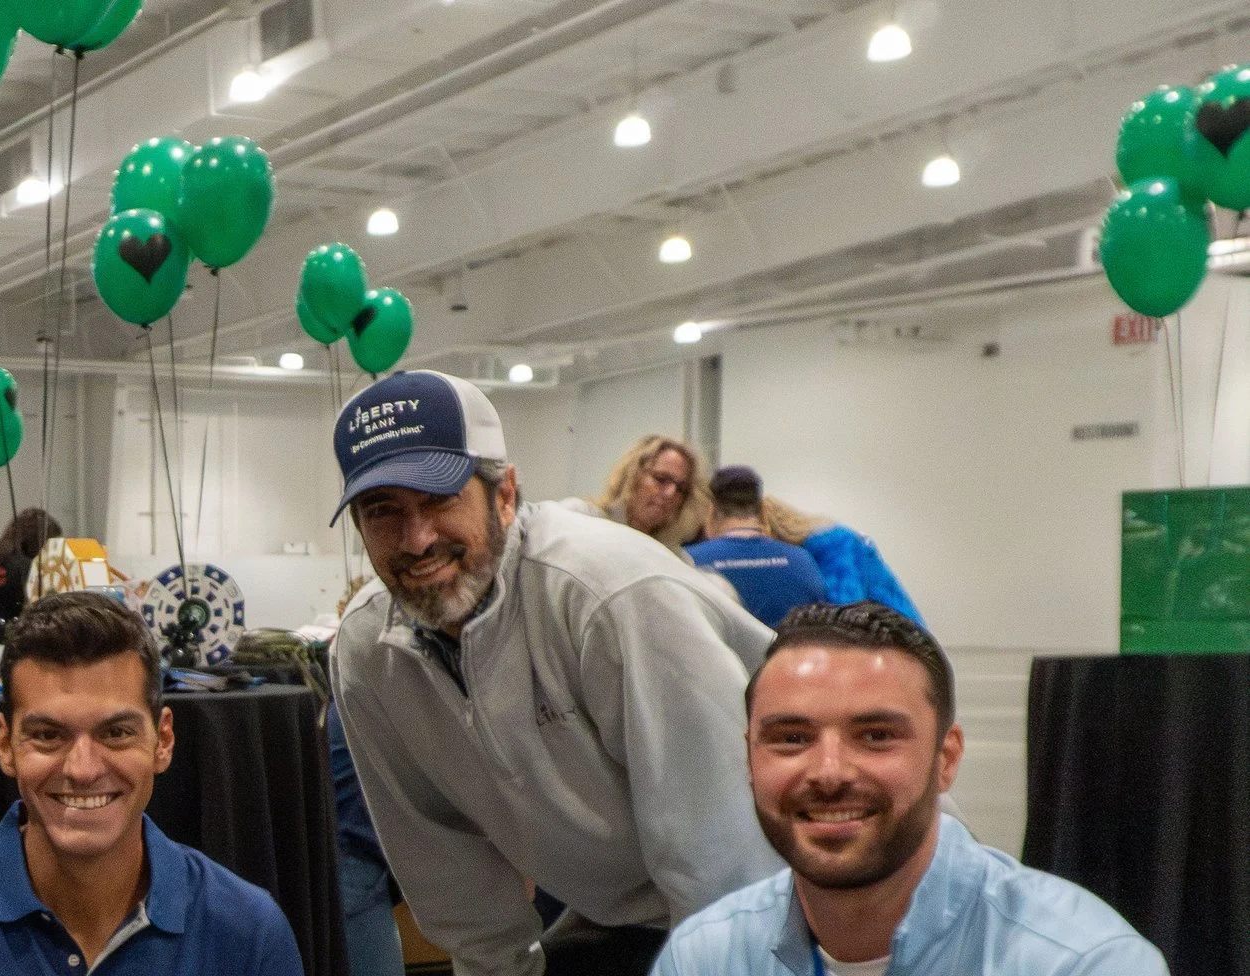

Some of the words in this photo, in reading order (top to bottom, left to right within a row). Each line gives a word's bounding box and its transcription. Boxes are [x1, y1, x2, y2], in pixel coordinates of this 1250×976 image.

[349, 399, 420, 432] LIBERTY
[365, 416, 396, 434] BANK
[359, 429, 400, 449] Community
